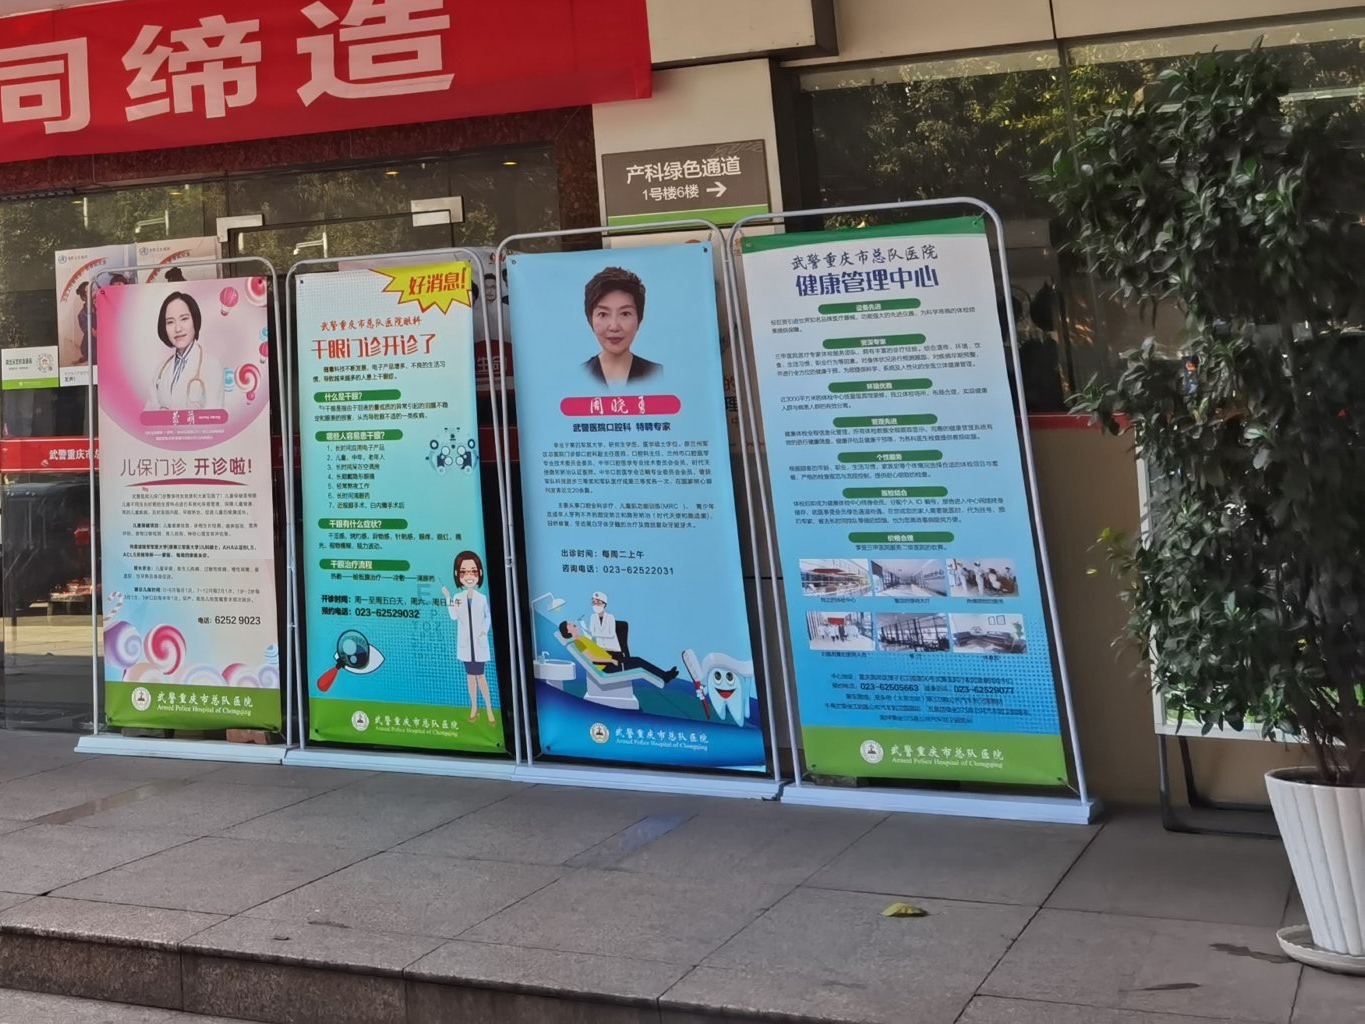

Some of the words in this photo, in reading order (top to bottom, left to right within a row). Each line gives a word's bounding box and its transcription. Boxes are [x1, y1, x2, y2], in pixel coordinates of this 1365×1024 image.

[625, 155, 742, 184] 产科绿色通道
[642, 184, 699, 201] 1号楼6楼
[791, 244, 939, 270] 武警重庆市总队医院
[795, 264, 939, 297] 健康管理中心
[310, 333, 437, 360] 干眼门诊开诊了
[572, 422, 632, 432] 武警医院口腔科
[636, 422, 671, 431] 特聘专家
[120, 458, 187, 476] 儿保门诊
[238, 616, 261, 625] 9023
[157, 690, 254, 708] 武警重庆市总队医院
[890, 745, 1004, 761] 武警重庆市总队医院
